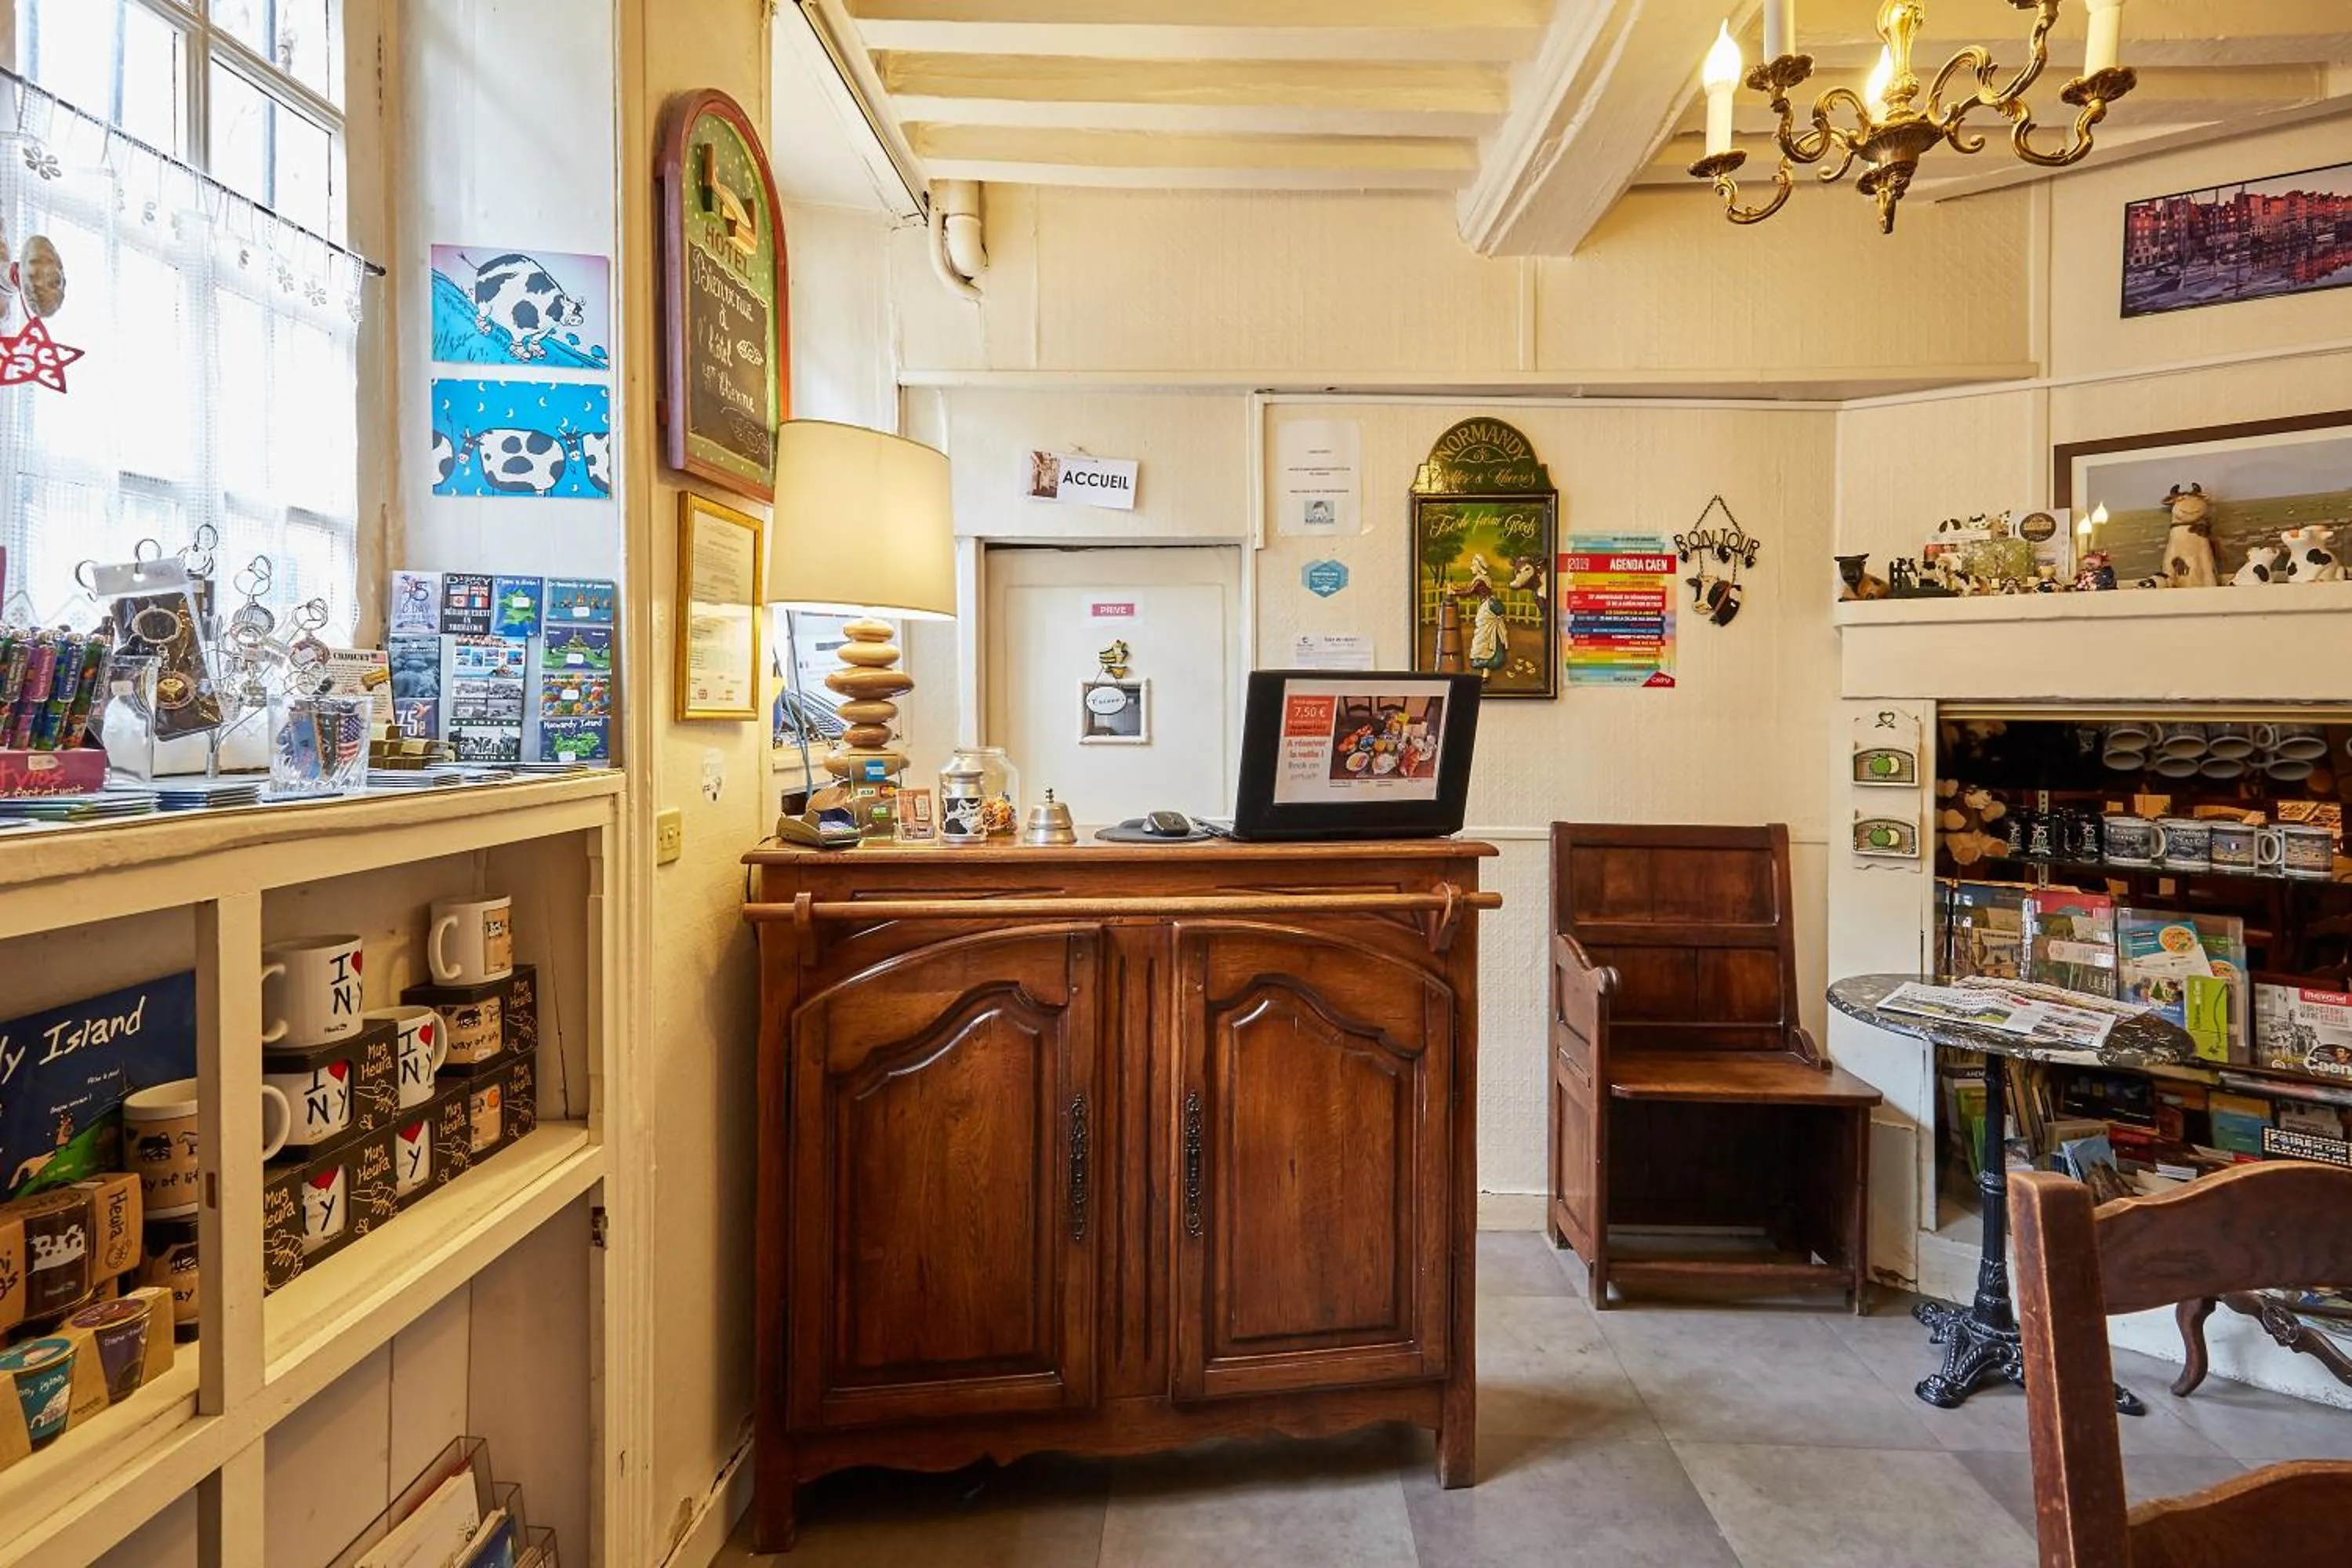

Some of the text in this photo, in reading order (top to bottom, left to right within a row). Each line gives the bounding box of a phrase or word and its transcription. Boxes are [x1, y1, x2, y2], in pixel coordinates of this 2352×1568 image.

[706, 225, 752, 282] HOTEL
[1436, 423, 1530, 461] NORMANDY
[1062, 470, 1130, 490] ACCUEIL
[1673, 528, 1761, 559] BONJOUR
[1610, 558, 1644, 572] AGENDA
[1645, 559, 1668, 572] CAEN
[329, 952, 351, 985] I
[39, 995, 146, 1066] Island
[368, 1042, 388, 1060] Mug
[365, 1144, 386, 1163] Mug
